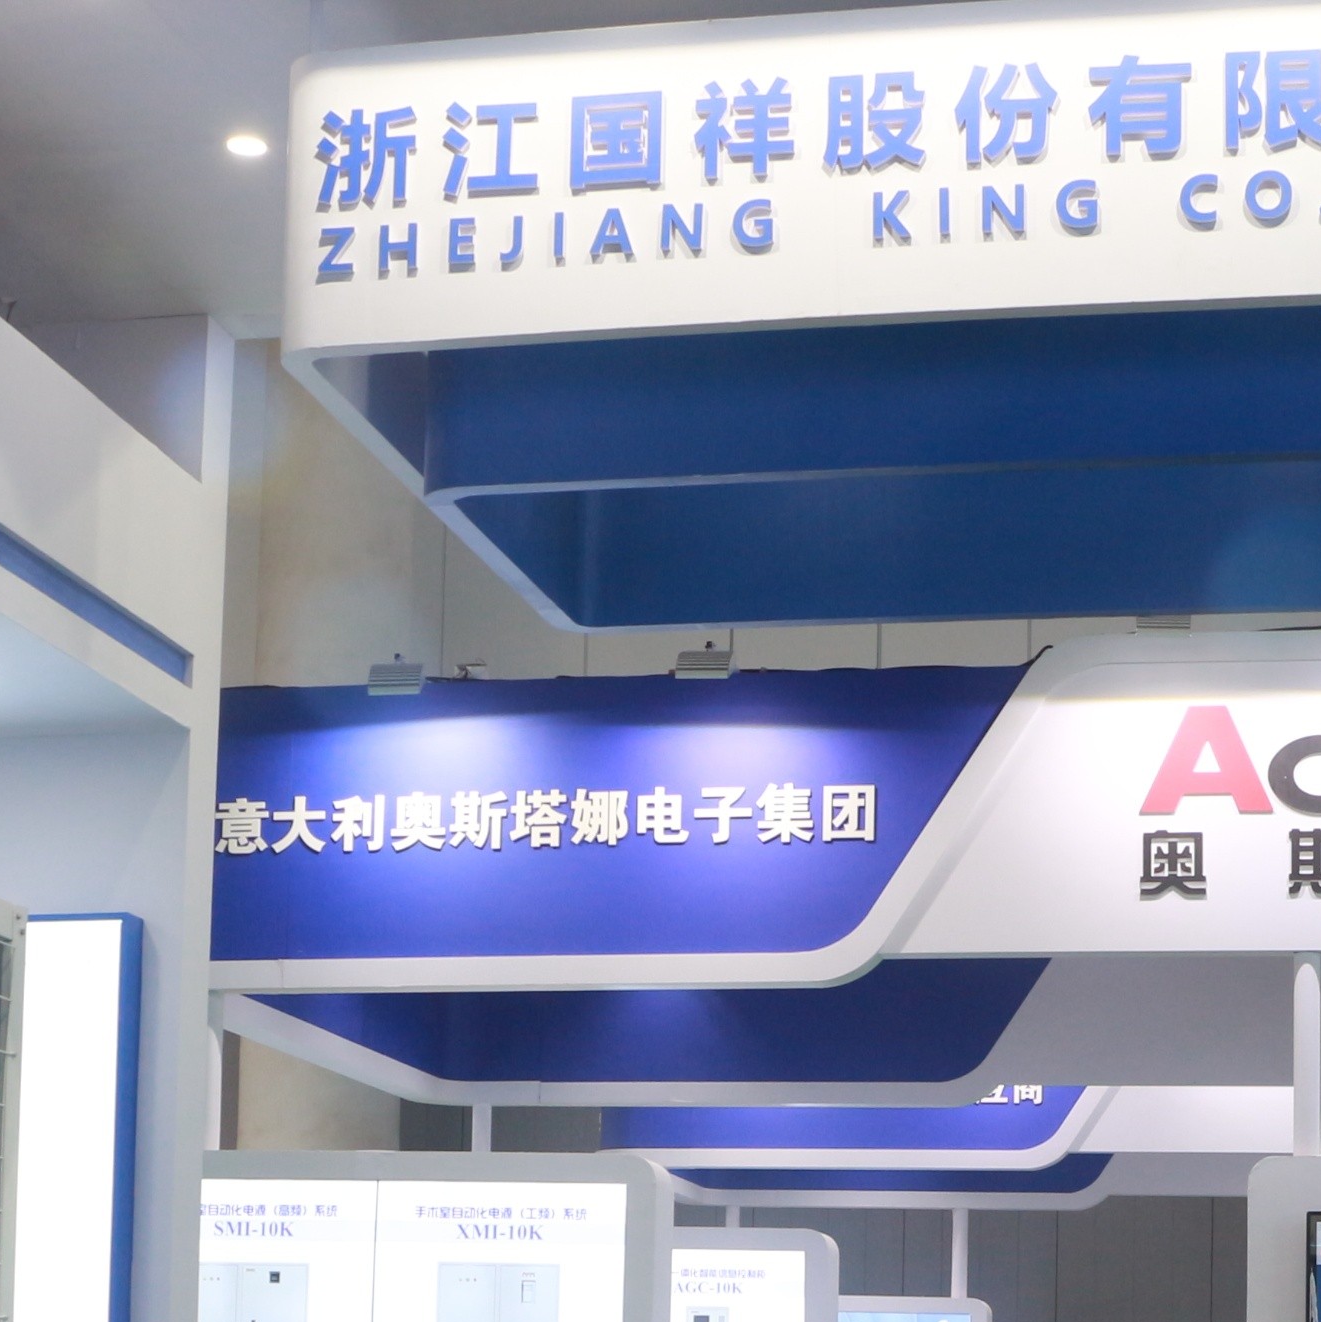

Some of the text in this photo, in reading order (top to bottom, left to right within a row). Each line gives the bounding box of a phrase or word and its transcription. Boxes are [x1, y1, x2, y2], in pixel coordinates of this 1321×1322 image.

[318, 197, 779, 278] ZHEJIANG
[873, 178, 1103, 246] KING
[214, 782, 876, 855] 意大利奥斯塔娜电子集团
[214, 1220, 294, 1237] SMI-10K
[456, 1223, 543, 1240] XMI-10K
